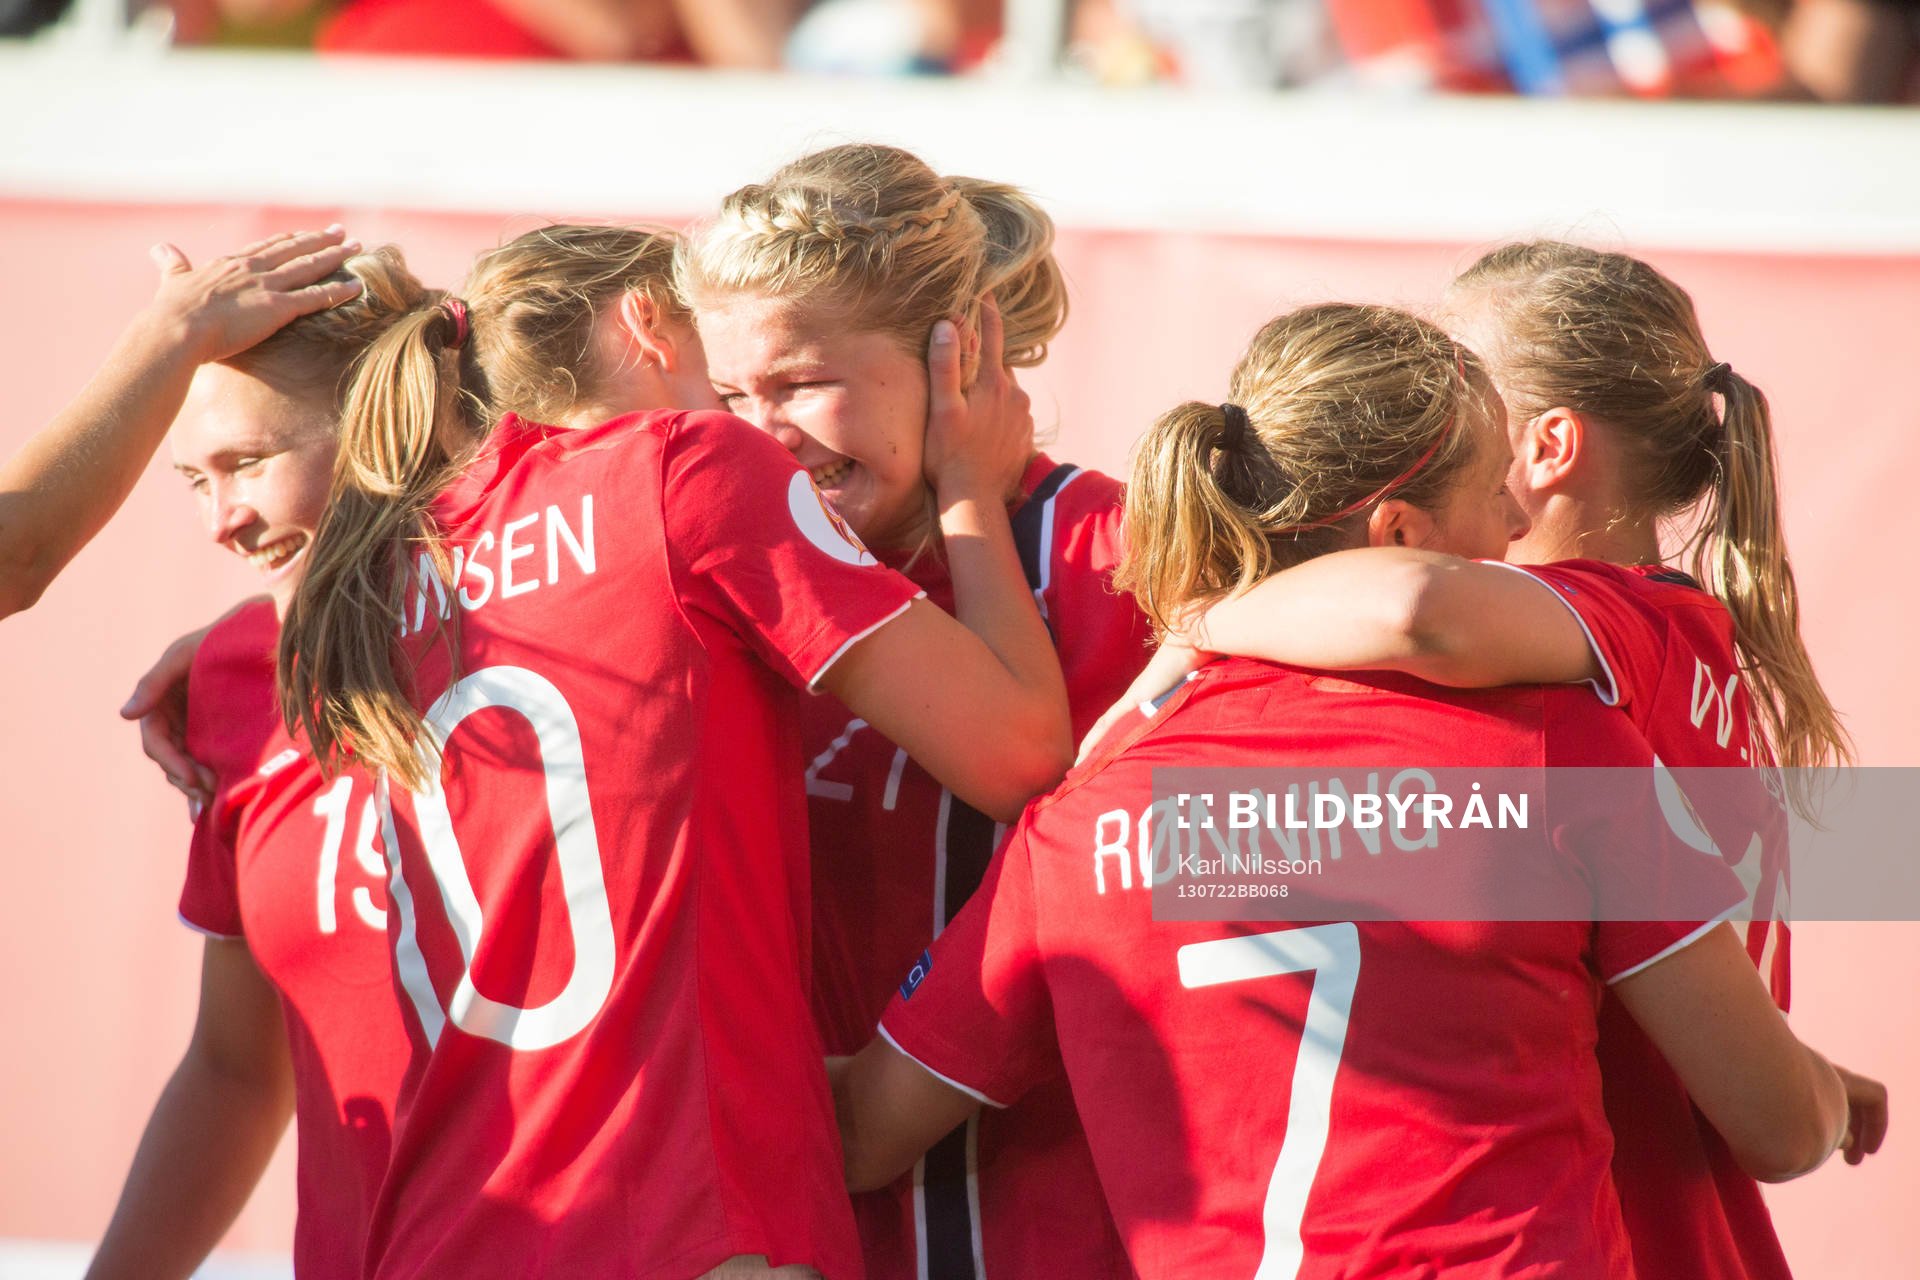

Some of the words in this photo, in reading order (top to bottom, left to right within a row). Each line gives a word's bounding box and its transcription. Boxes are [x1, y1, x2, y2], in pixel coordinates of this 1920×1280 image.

[401, 494, 596, 637] NSEN
[1094, 768, 1439, 895] RØNNING
[1177, 921, 1361, 1280] 7
